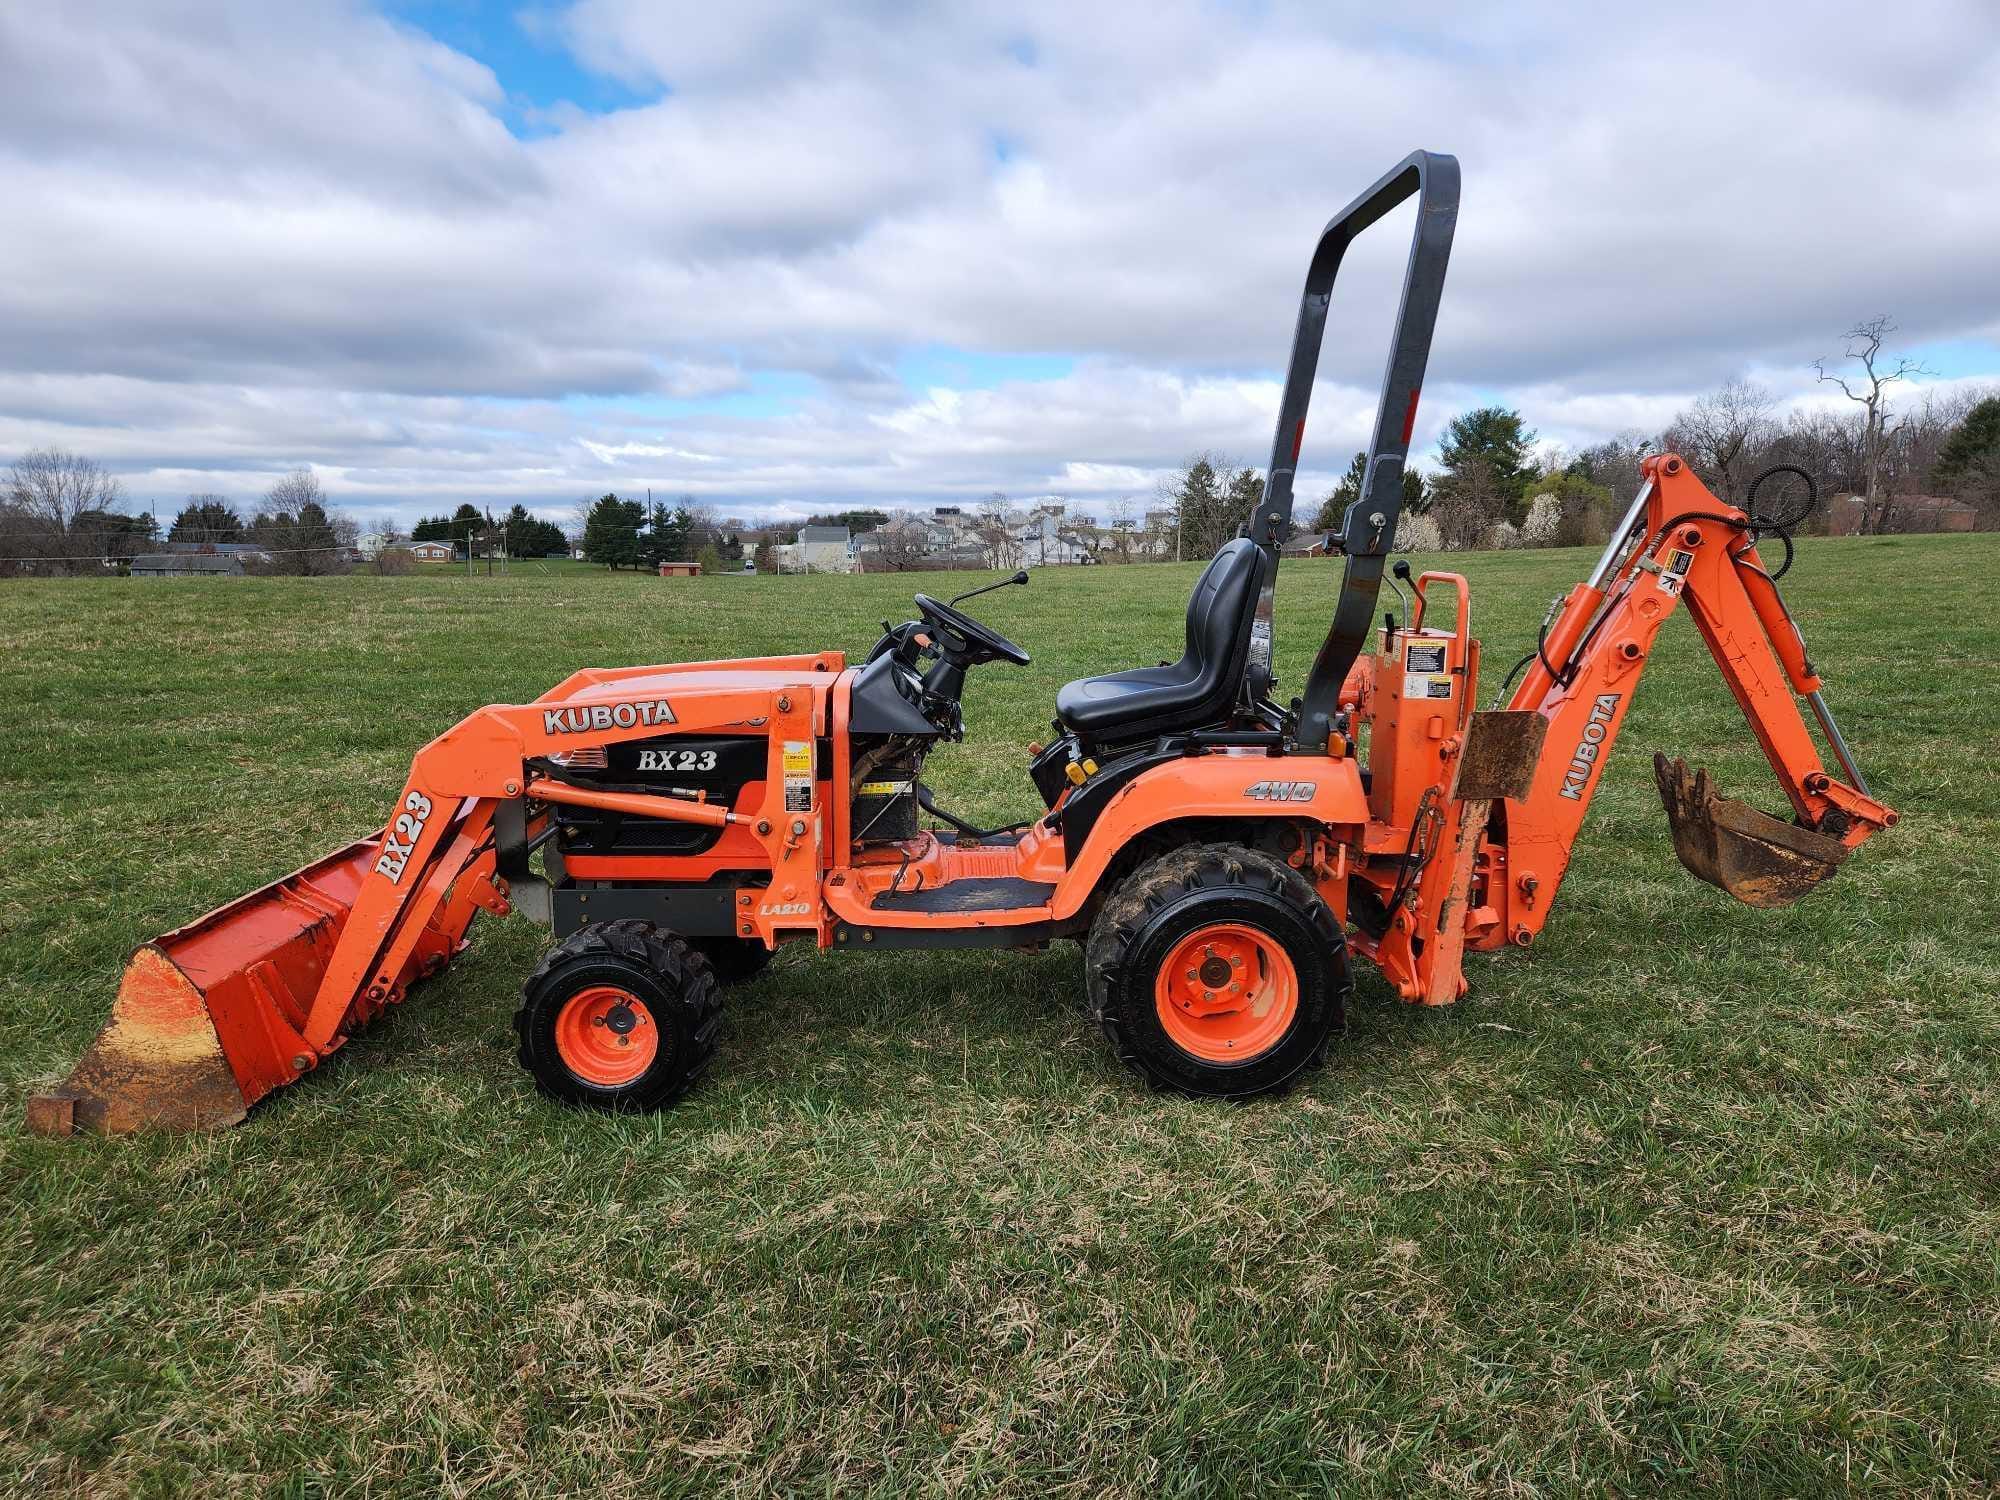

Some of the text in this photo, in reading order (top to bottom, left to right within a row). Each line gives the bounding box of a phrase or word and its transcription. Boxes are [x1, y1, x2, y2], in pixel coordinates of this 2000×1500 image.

[543, 700, 678, 734] KUBOTA
[636, 750, 718, 771] BX23
[1560, 694, 1622, 801] KUBOTA
[1243, 781, 1317, 802] 4WD
[374, 791, 432, 885] BX23
[760, 903, 811, 916] LA210
